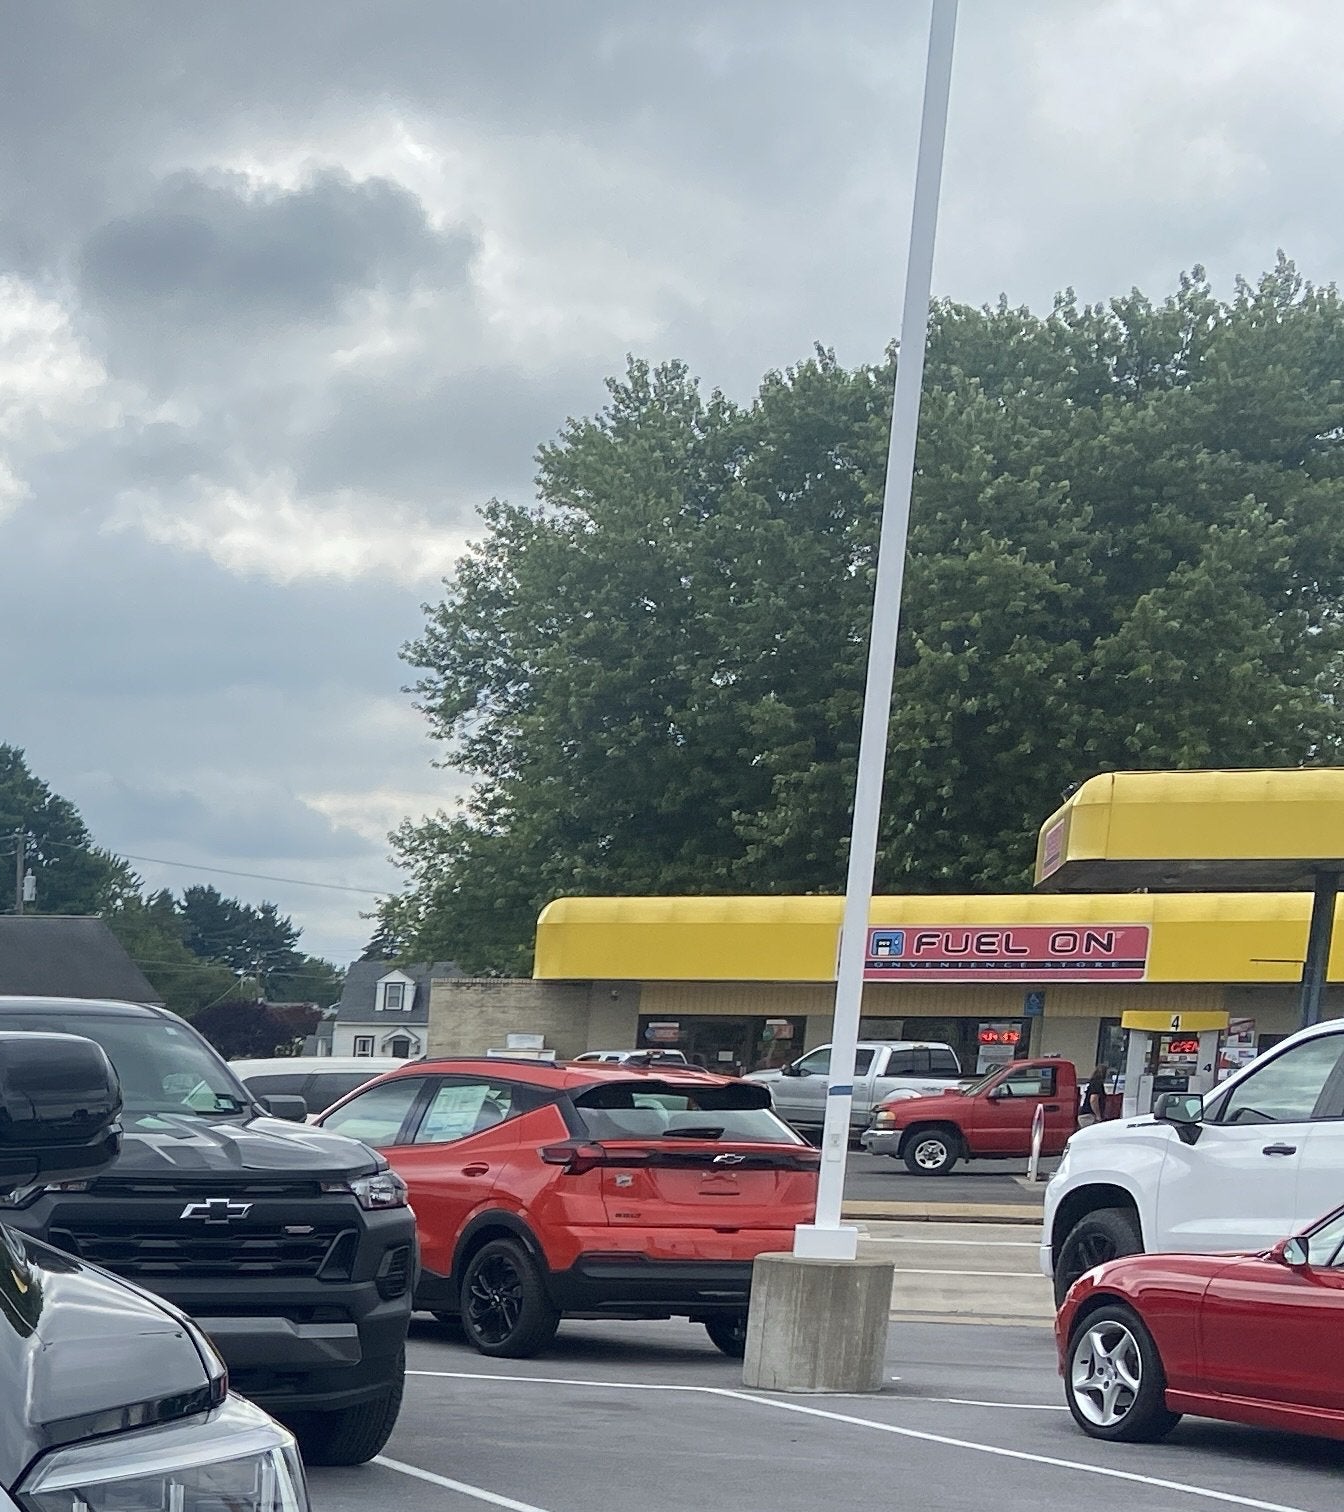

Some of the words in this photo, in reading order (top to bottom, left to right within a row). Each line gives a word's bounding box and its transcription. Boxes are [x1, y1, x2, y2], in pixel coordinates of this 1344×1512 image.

[913, 932, 1030, 956] FUEL
[1048, 932, 1116, 956] ON
[873, 961, 1028, 969] ONVENIENCE
[1043, 961, 1119, 969] STORE
[1171, 1015, 1180, 1031] 4
